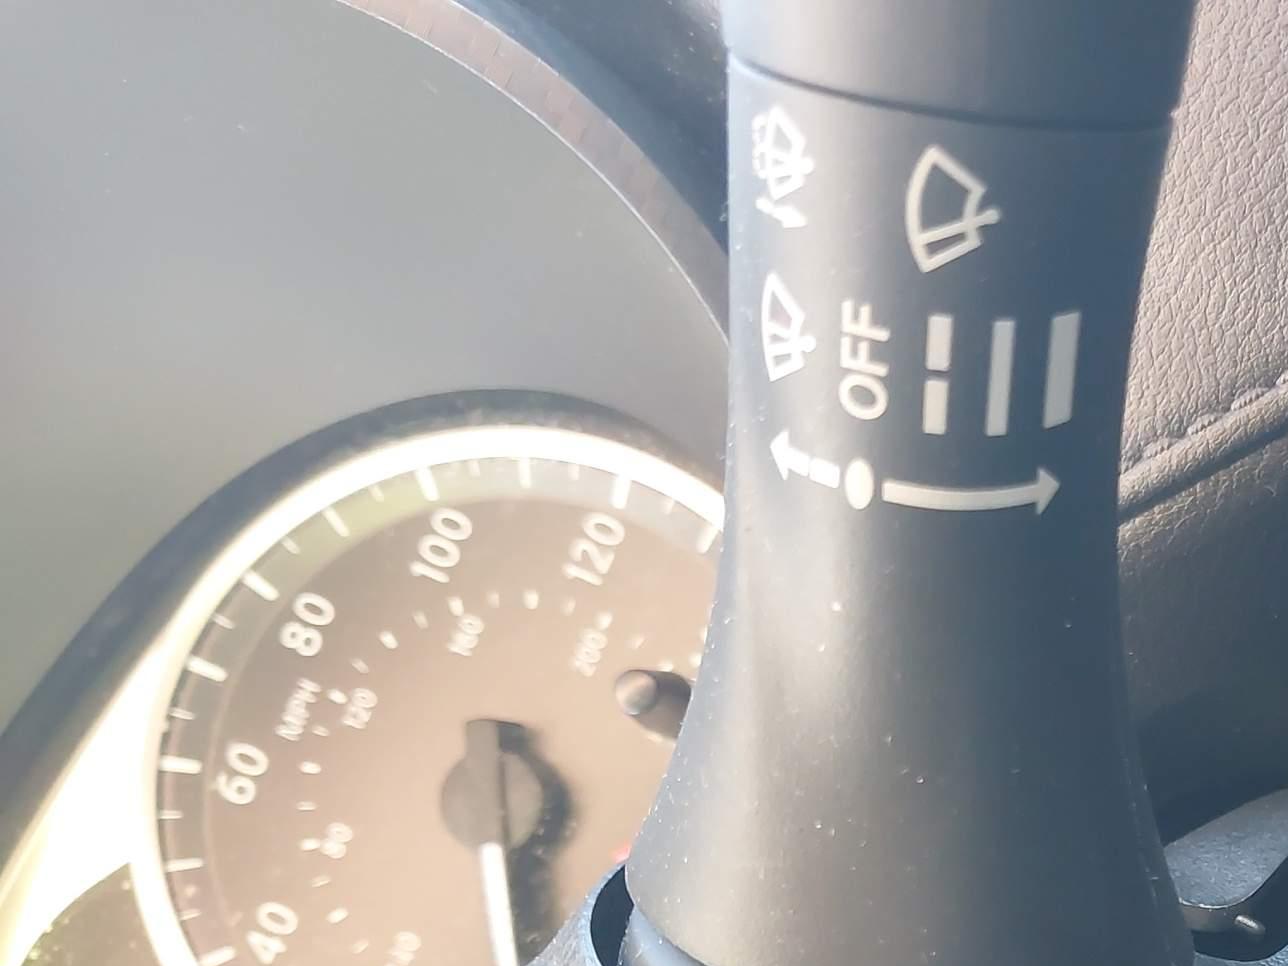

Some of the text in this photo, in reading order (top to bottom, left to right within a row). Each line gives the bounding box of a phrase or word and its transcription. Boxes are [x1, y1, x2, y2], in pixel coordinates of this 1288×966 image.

[839, 299, 890, 420] OFF
[410, 507, 473, 583] 100
[562, 511, 625, 586] 120
[279, 592, 336, 657] 80
[216, 742, 270, 805] 60
[246, 902, 299, 965] 40
